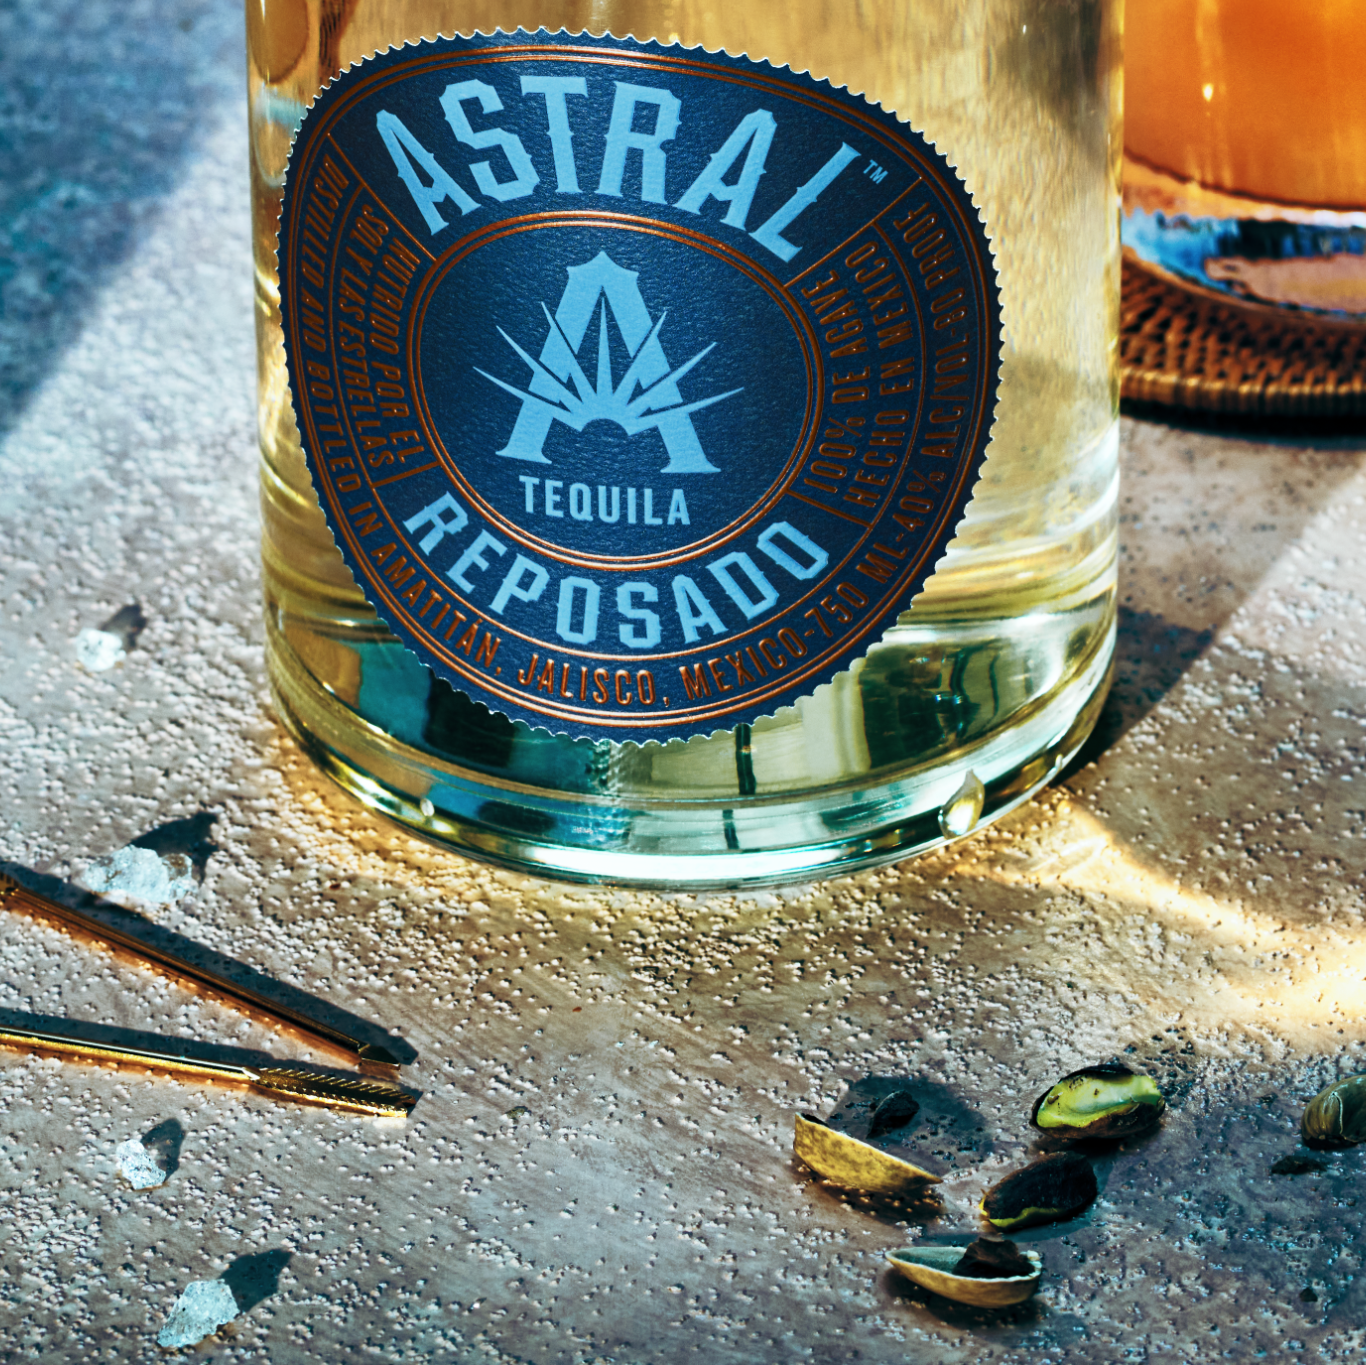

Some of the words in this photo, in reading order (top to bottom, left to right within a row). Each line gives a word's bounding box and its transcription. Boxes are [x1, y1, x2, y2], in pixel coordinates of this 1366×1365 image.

[376, 75, 861, 263] ASTRAL
[301, 153, 350, 289] DISTILLED
[349, 204, 389, 255] SOL
[893, 202, 961, 291] PROOF
[339, 267, 368, 321] LAS
[346, 246, 374, 276] Y
[369, 237, 421, 355] NUTRIDO
[845, 241, 913, 349] MEXICO
[301, 286, 327, 352] AND
[801, 269, 868, 358] AGAVE
[339, 320, 395, 468] ESTRELLAS
[371, 360, 410, 418] POR
[832, 365, 871, 404] DE
[880, 356, 915, 396] EN
[306, 359, 362, 493] BOTTLED
[389, 429, 425, 464] EL
[803, 417, 866, 494] 100%
[843, 409, 910, 508] HECHO
[348, 501, 384, 537] IN
[519, 474, 691, 526] TEQUILA
[402, 491, 829, 649] REPOSADO
